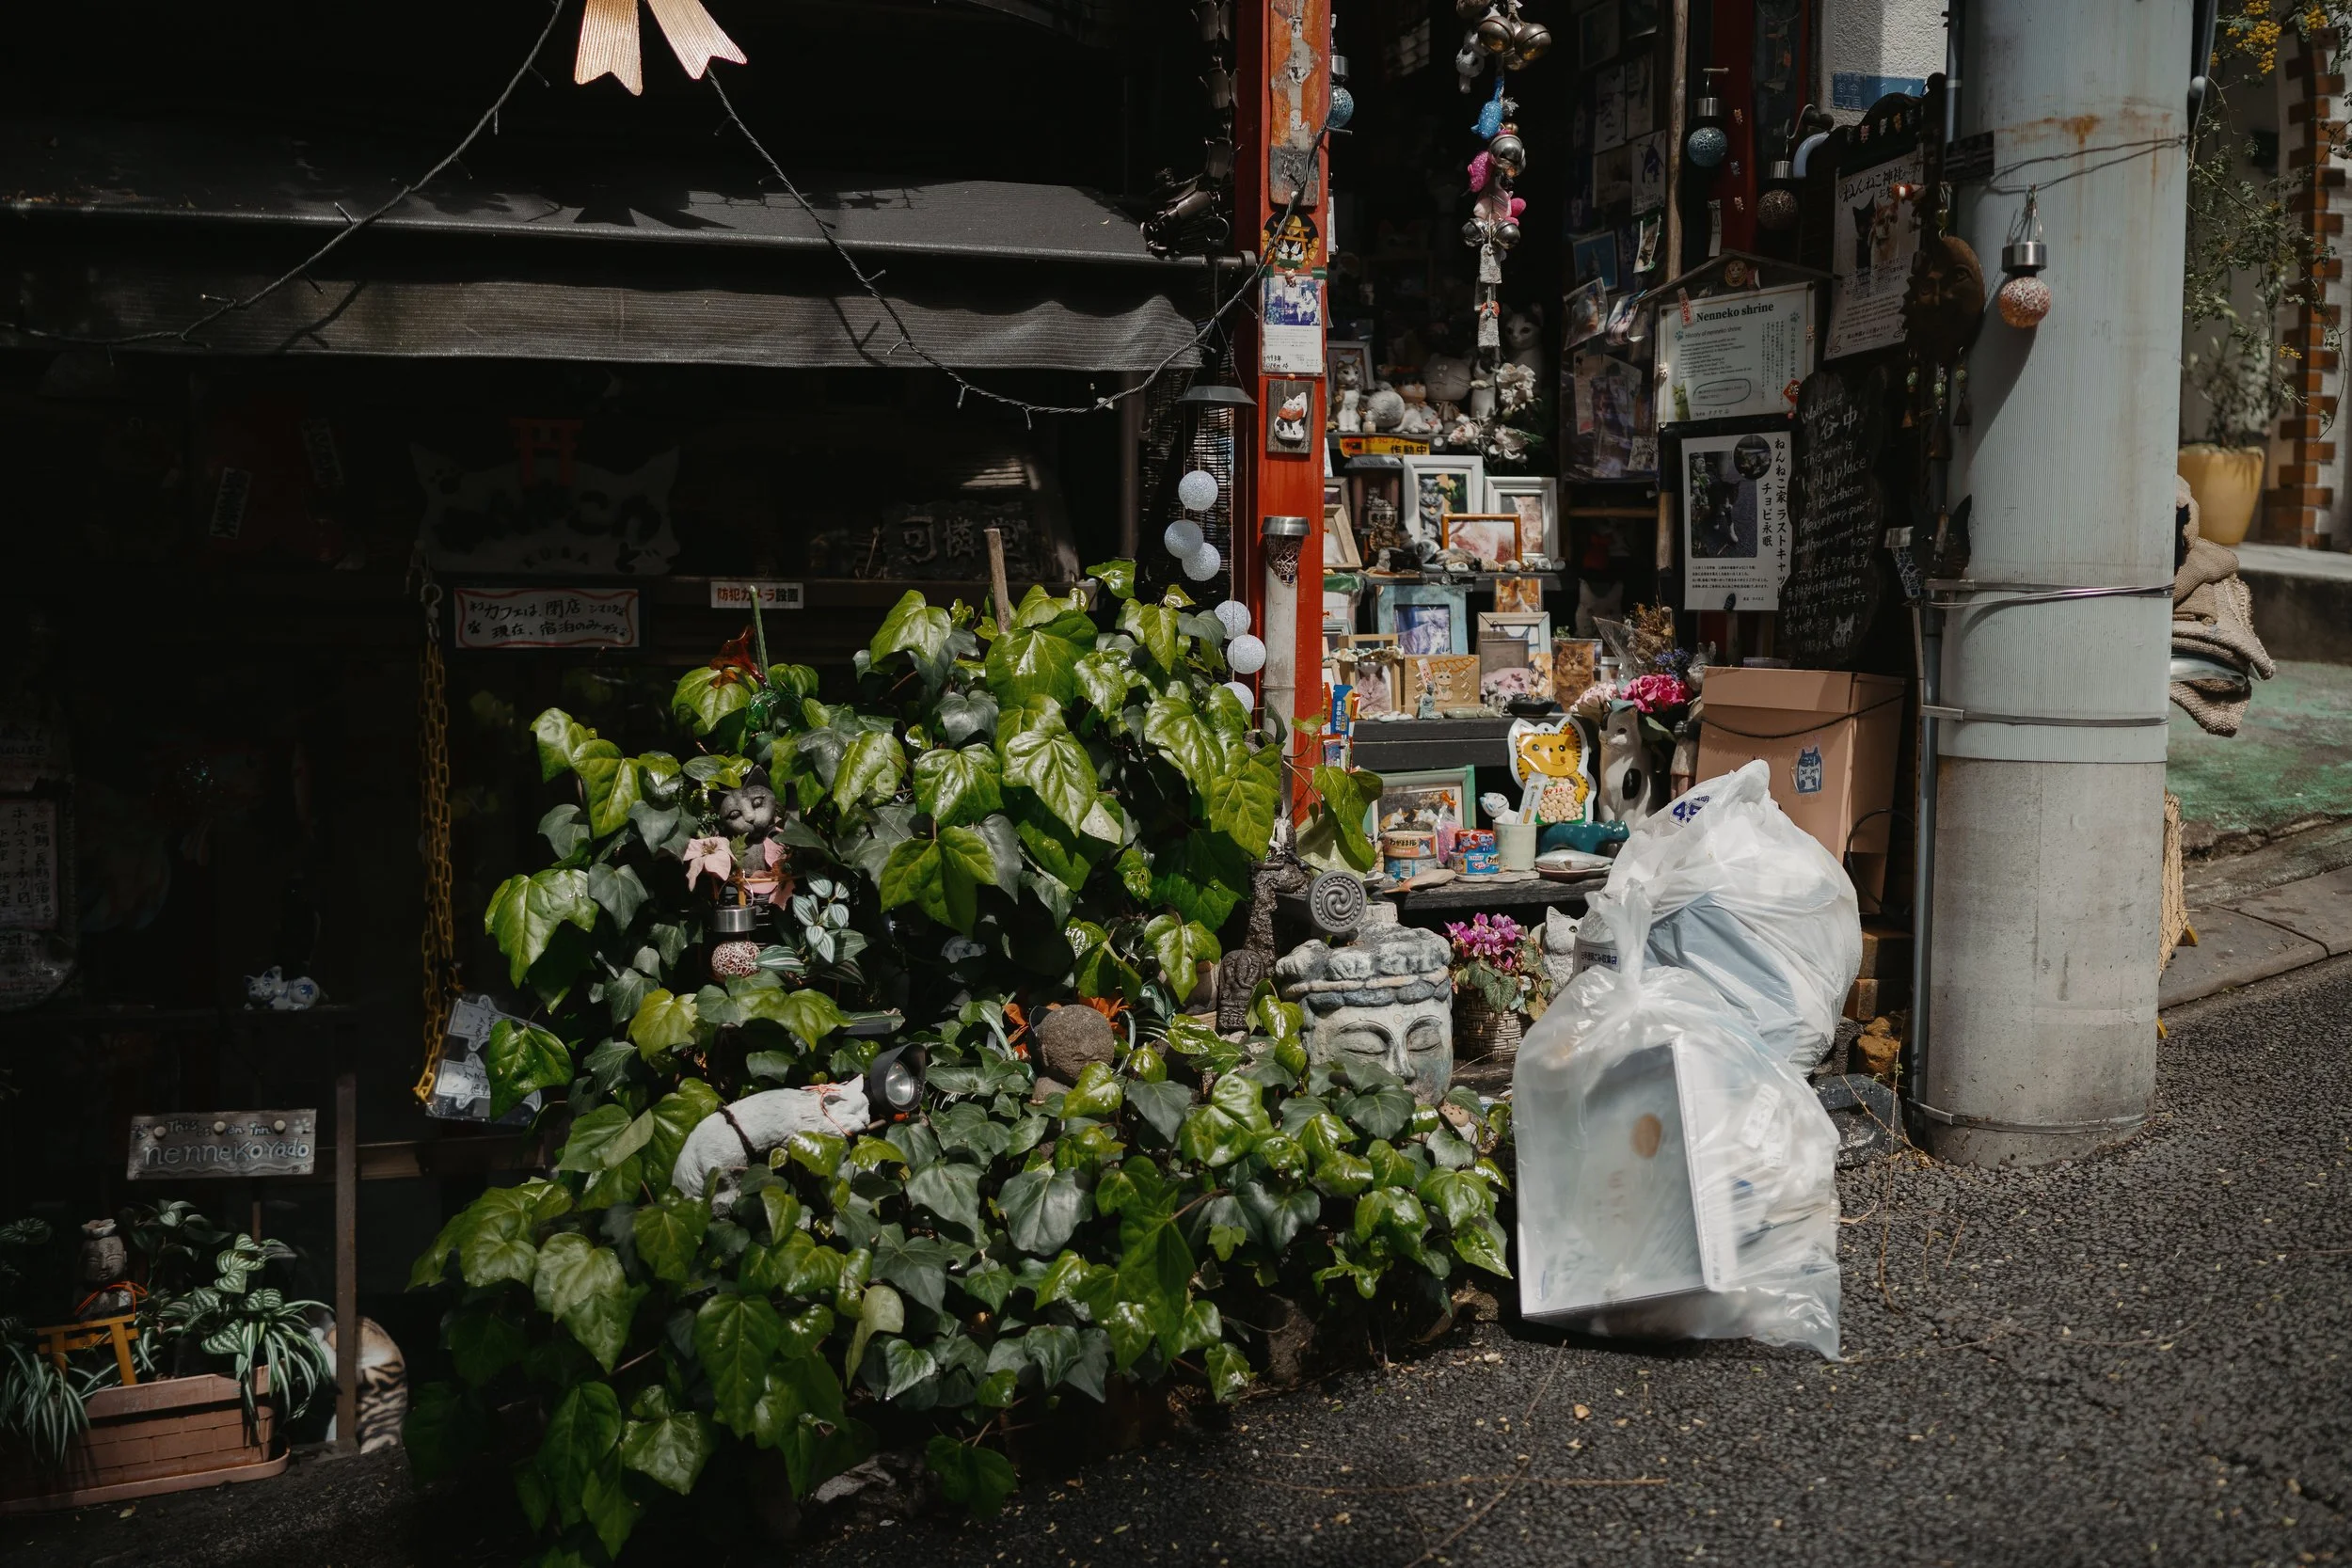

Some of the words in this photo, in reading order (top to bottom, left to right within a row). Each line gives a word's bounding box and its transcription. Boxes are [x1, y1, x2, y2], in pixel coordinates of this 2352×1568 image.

[1836, 82, 1859, 93] 谷中
[1696, 309, 1740, 323] Nenneko
[1741, 302, 1774, 316] shrine
[1820, 404, 1858, 439] 谷中
[1391, 444, 1426, 455] 作動中
[1803, 451, 1821, 467] This
[1845, 440, 1852, 451] is
[1774, 437, 1788, 503] ねんねこ家
[1835, 457, 1867, 487] place
[1819, 484, 1865, 510] Buddhism
[1762, 483, 1773, 547] チョビ永眠
[1800, 516, 1828, 537] Please
[165, 1119, 198, 1133] This
[226, 1124, 244, 1135] an
